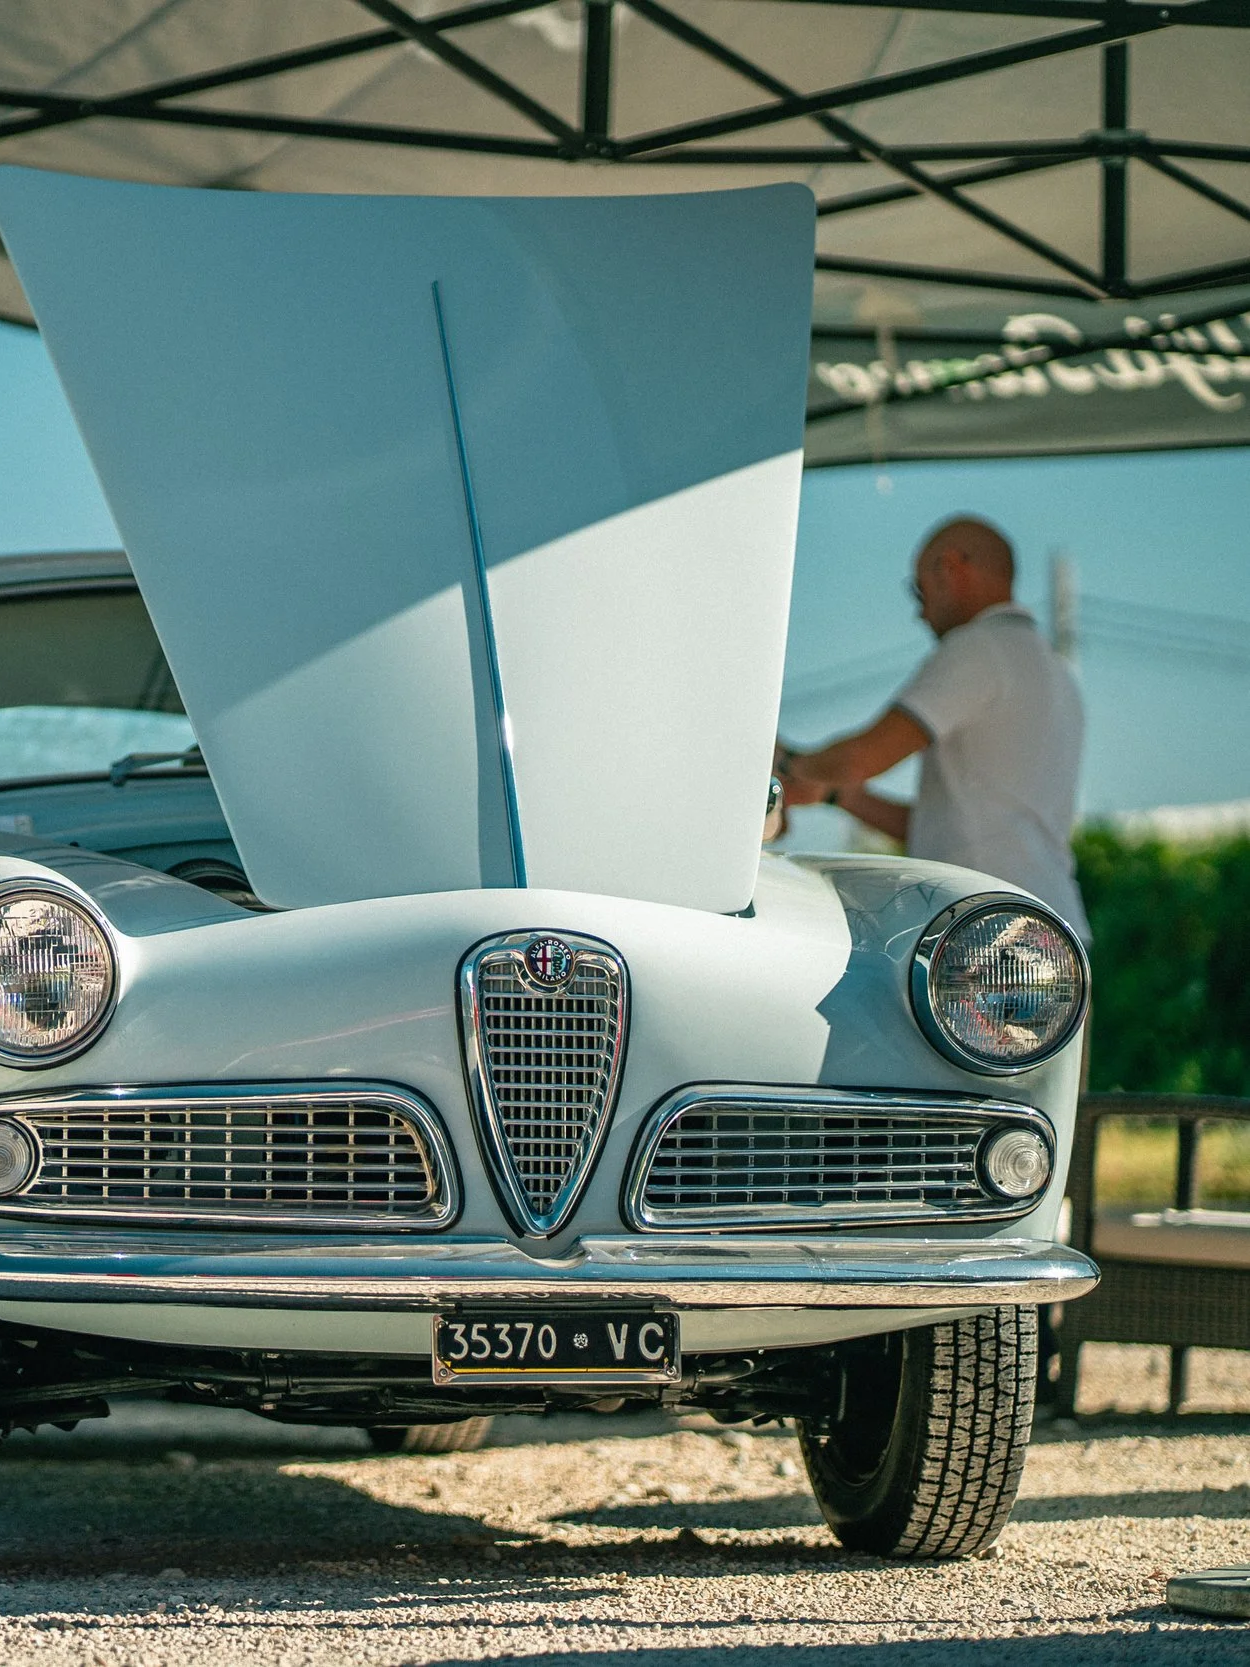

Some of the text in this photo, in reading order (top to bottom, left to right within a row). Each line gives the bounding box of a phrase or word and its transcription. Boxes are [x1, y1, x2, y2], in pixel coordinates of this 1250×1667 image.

[536, 971, 566, 981] MILANO
[448, 1322, 665, 1361] 35370 VC
